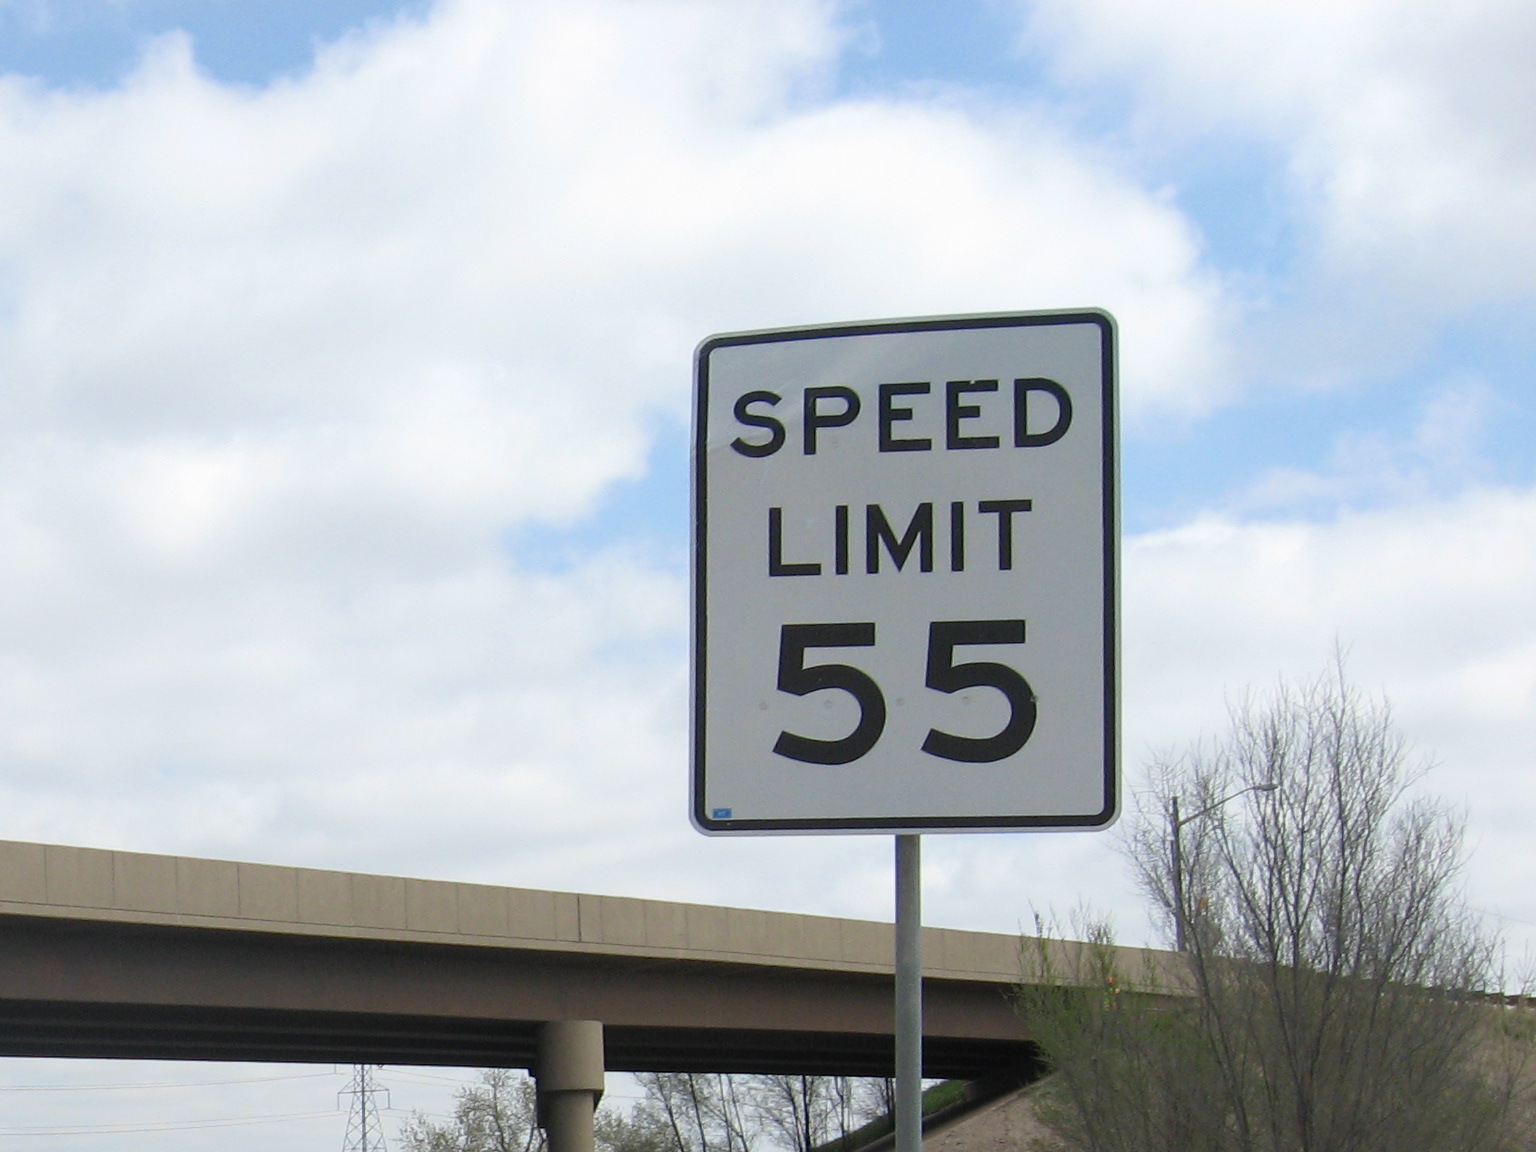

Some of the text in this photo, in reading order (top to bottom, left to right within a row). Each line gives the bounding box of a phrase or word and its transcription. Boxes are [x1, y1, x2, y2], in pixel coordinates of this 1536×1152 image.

[730, 377, 1073, 458] SPEED
[768, 498, 1032, 577] LIMIT
[772, 619, 1037, 765] 55
